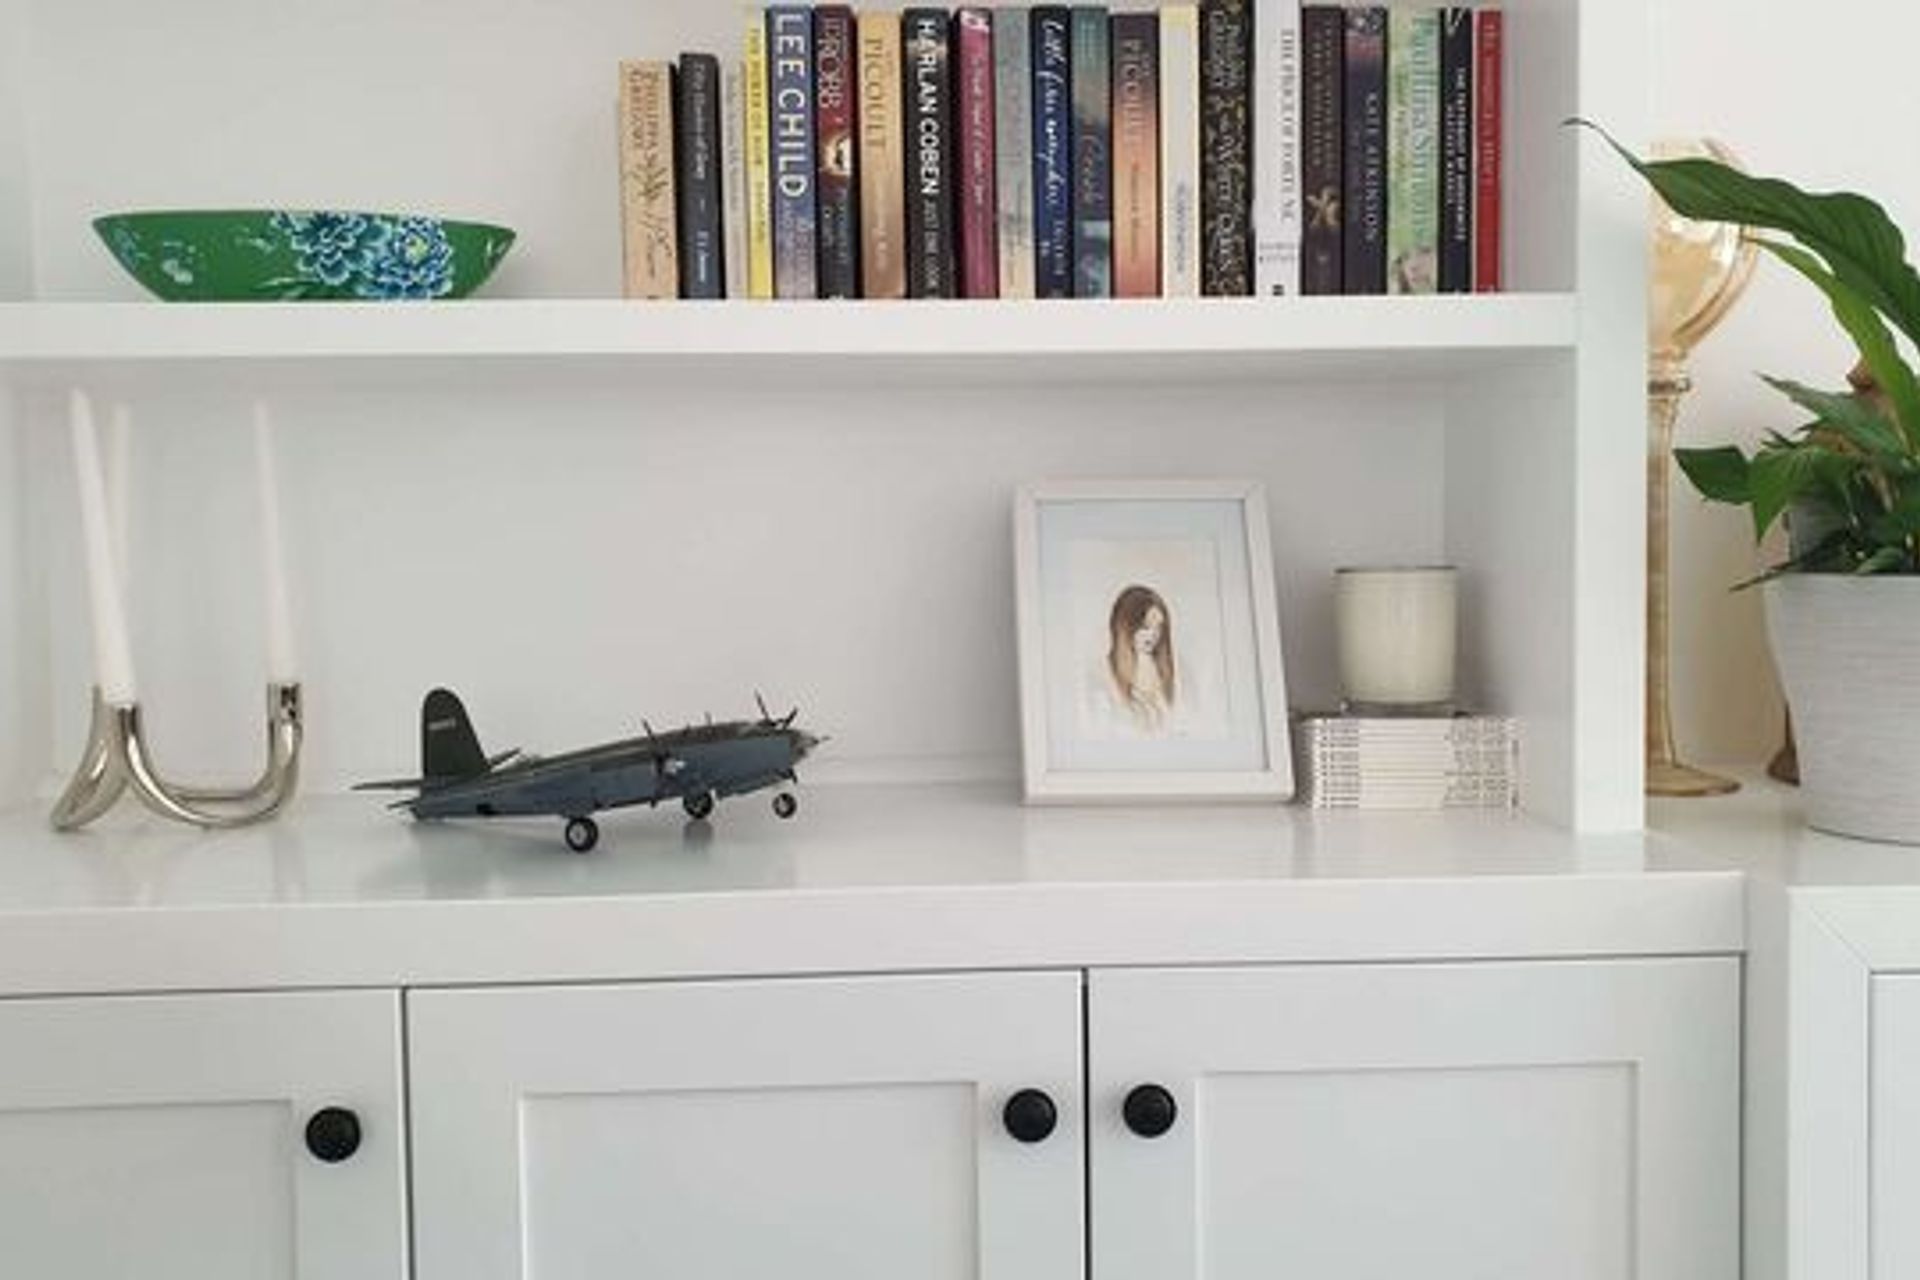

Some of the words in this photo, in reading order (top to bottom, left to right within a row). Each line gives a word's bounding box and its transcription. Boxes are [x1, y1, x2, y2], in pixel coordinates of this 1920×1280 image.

[777, 13, 805, 79] LEE
[817, 38, 845, 109] ROBB
[917, 19, 938, 113] HARLAN
[750, 60, 763, 108] POWER
[864, 38, 888, 149] PICOULT
[1121, 38, 1144, 147] PICOULT
[1365, 92, 1380, 137] KATE
[778, 88, 808, 197] CHILD
[919, 117, 942, 195] COBEN
[924, 198, 940, 229] JUST
[1364, 143, 1381, 242] ATKINSON
[924, 230, 940, 255] ONE
[924, 256, 940, 289] LOOK
